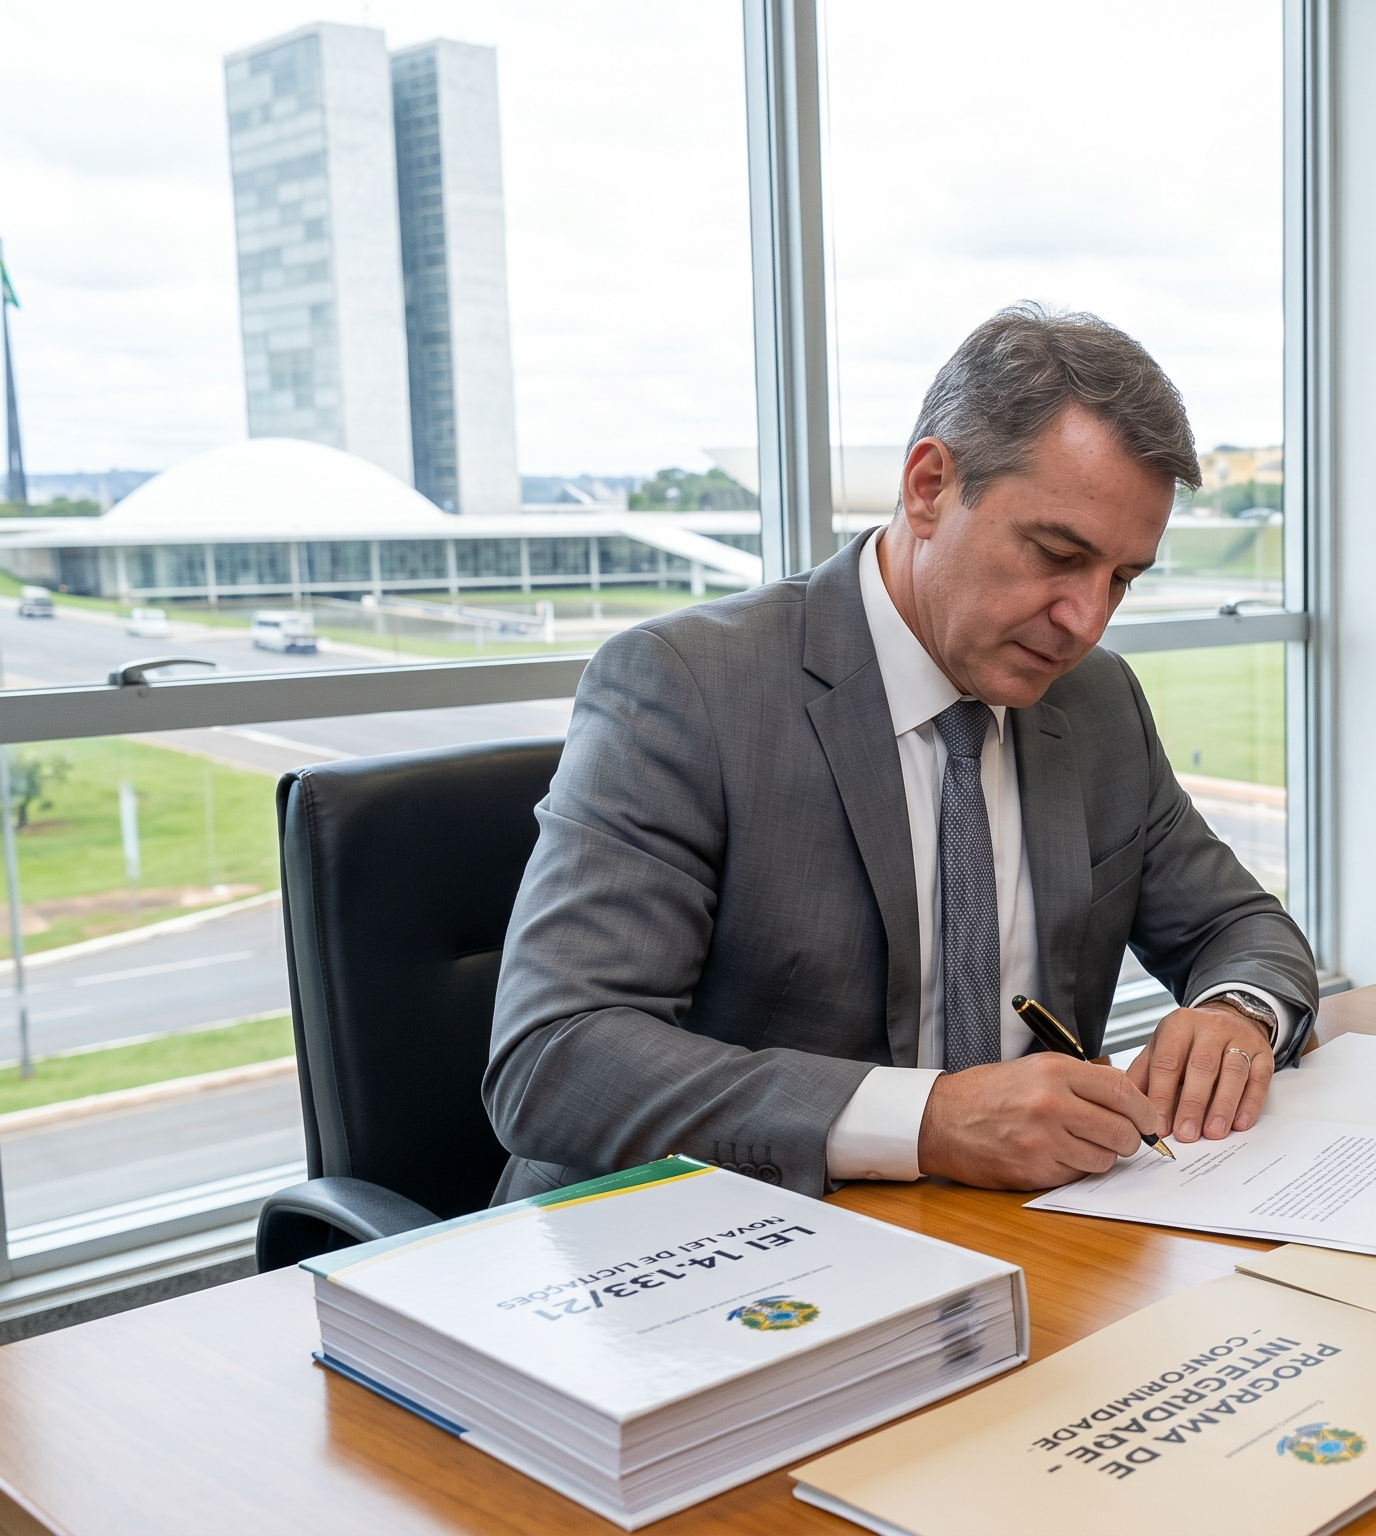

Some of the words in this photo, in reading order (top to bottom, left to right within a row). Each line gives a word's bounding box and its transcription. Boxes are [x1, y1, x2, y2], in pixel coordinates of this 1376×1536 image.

[678, 1236, 718, 1253] LEI
[745, 1225, 816, 1251] LEI
[639, 1250, 677, 1265] DE
[533, 1249, 744, 1322] 14.133/21
[1152, 1342, 1343, 1443] PROGRAMA
[1098, 1446, 1162, 1480] DE
